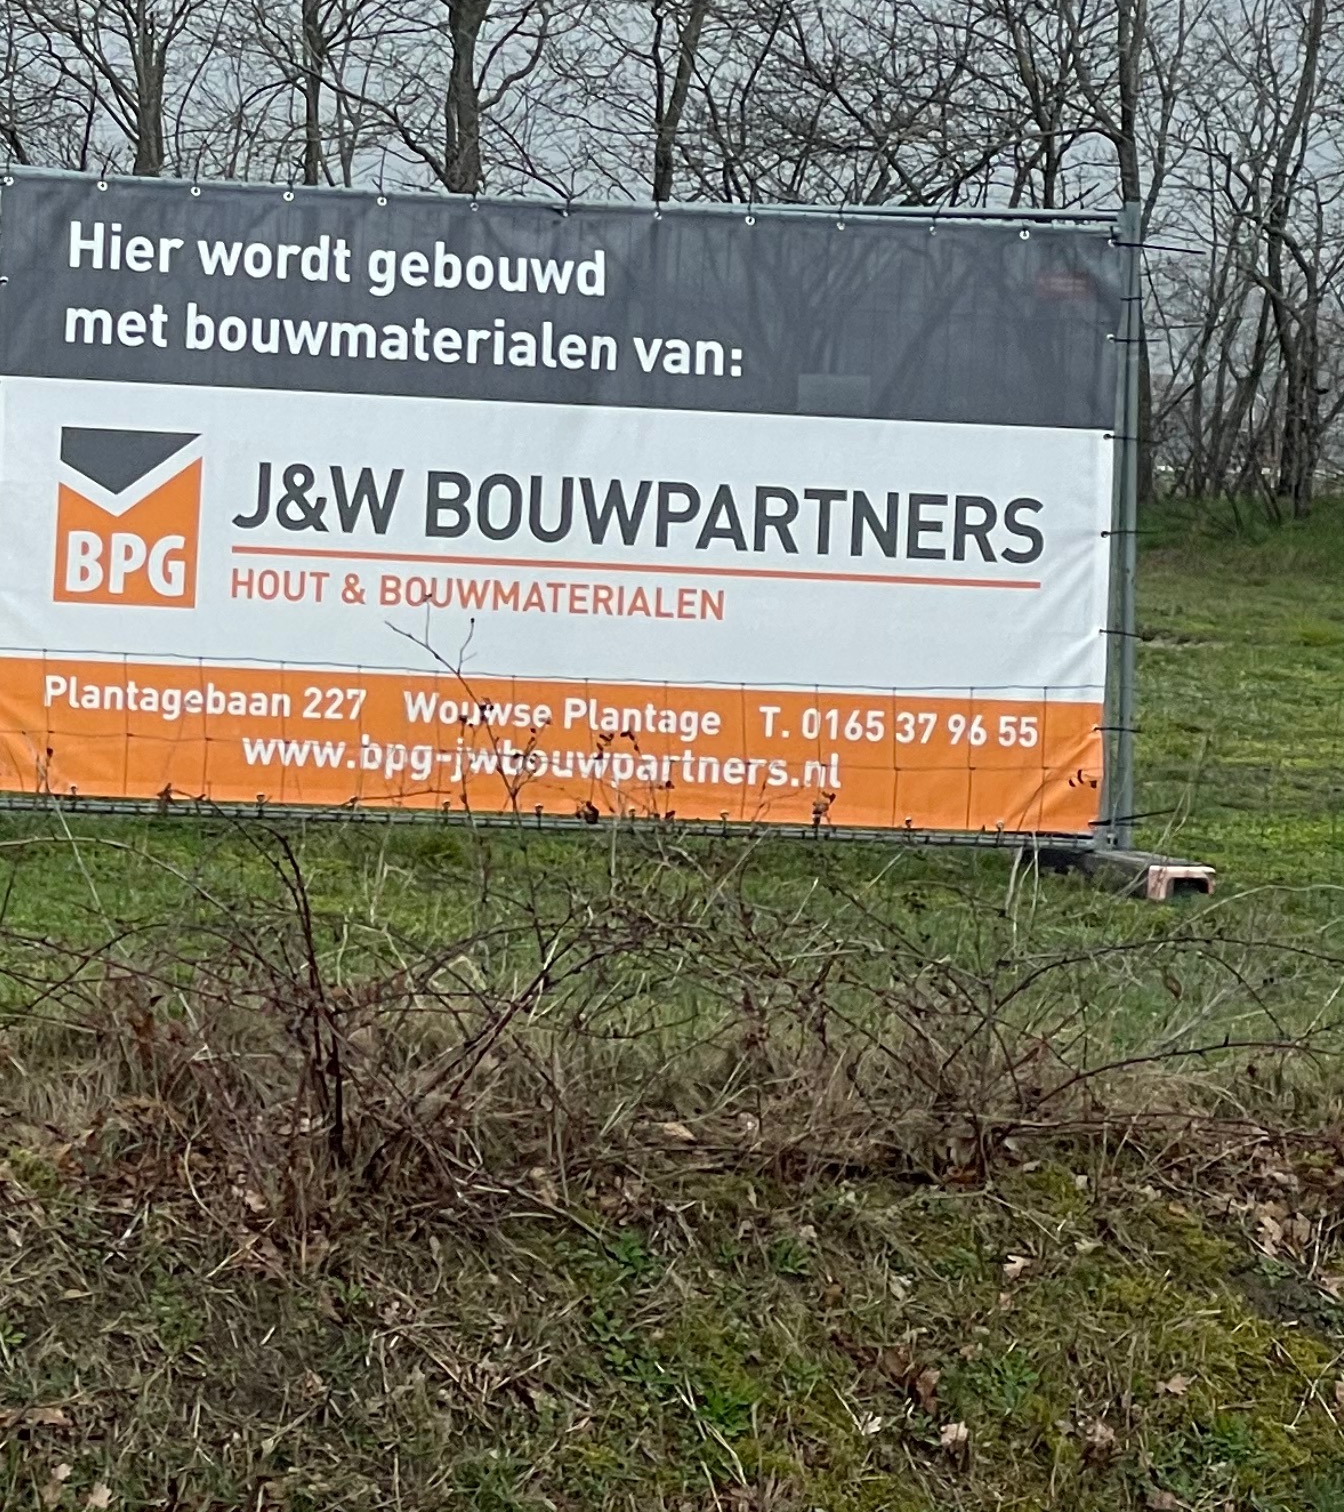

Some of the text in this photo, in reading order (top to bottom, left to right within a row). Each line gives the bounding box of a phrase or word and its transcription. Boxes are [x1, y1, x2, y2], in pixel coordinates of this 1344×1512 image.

[68, 220, 606, 297] Hier wordt gebouwd
[64, 302, 744, 377] met bouwmaterialen van:
[231, 462, 1045, 565] J&W BOUWPARTNERS
[64, 529, 187, 597] BPG
[231, 568, 726, 620] HOUT & BOUWMATERIALEN
[43, 674, 1039, 748] Plantagebaan 227 Wouwse Plantage T. 0165 37 96 55
[241, 734, 842, 789] www.bpg-jwbouwpartners.nl
